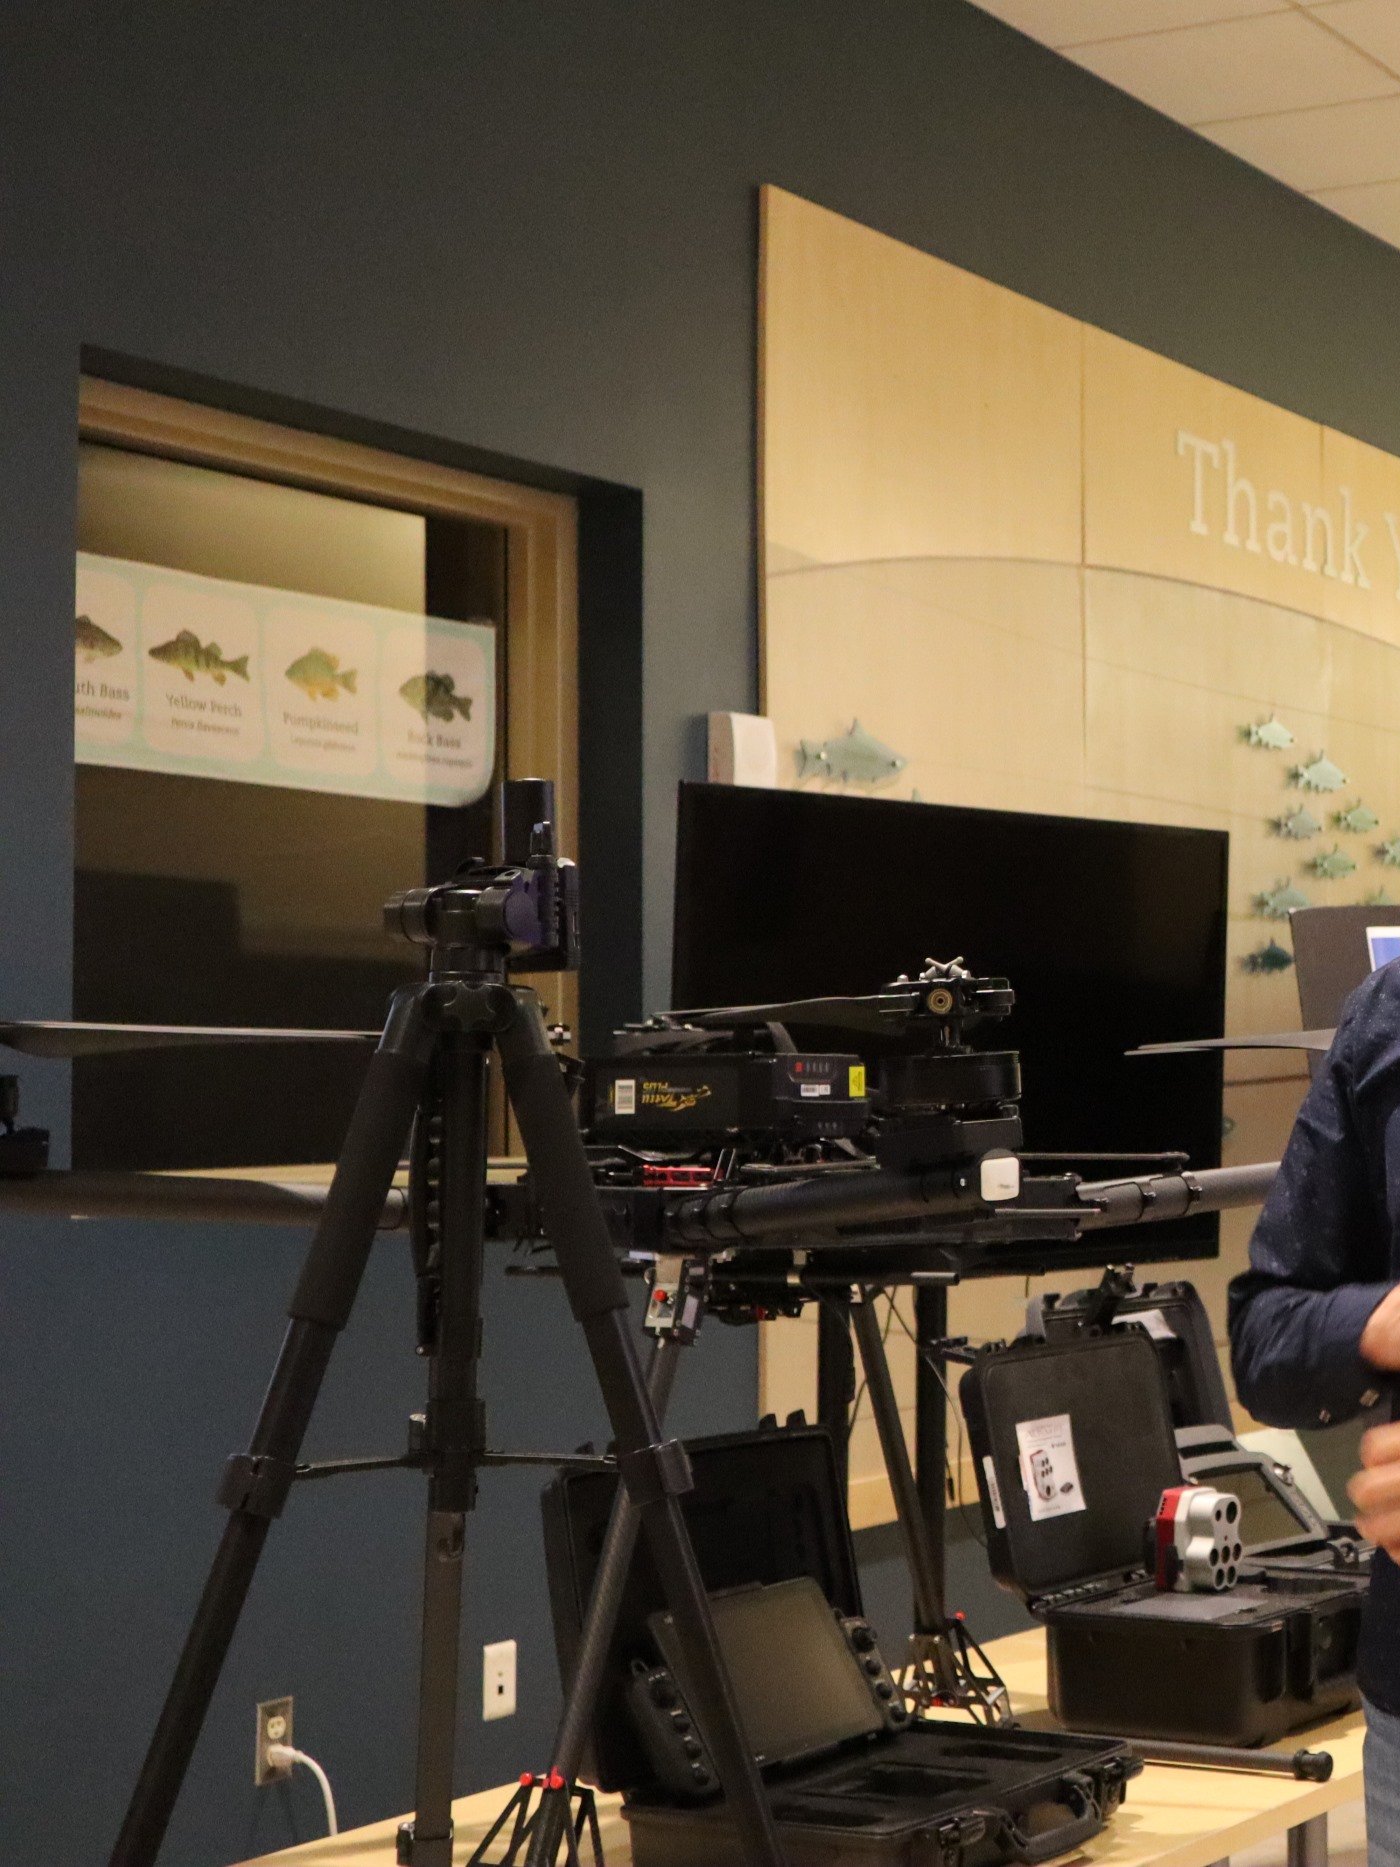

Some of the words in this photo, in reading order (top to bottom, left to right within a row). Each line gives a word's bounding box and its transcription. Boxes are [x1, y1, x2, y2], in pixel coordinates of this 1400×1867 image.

[1175, 429, 1371, 590] Thank
[99, 684, 130, 702] Bass
[166, 692, 207, 713] Yellow
[210, 700, 242, 717] Perch
